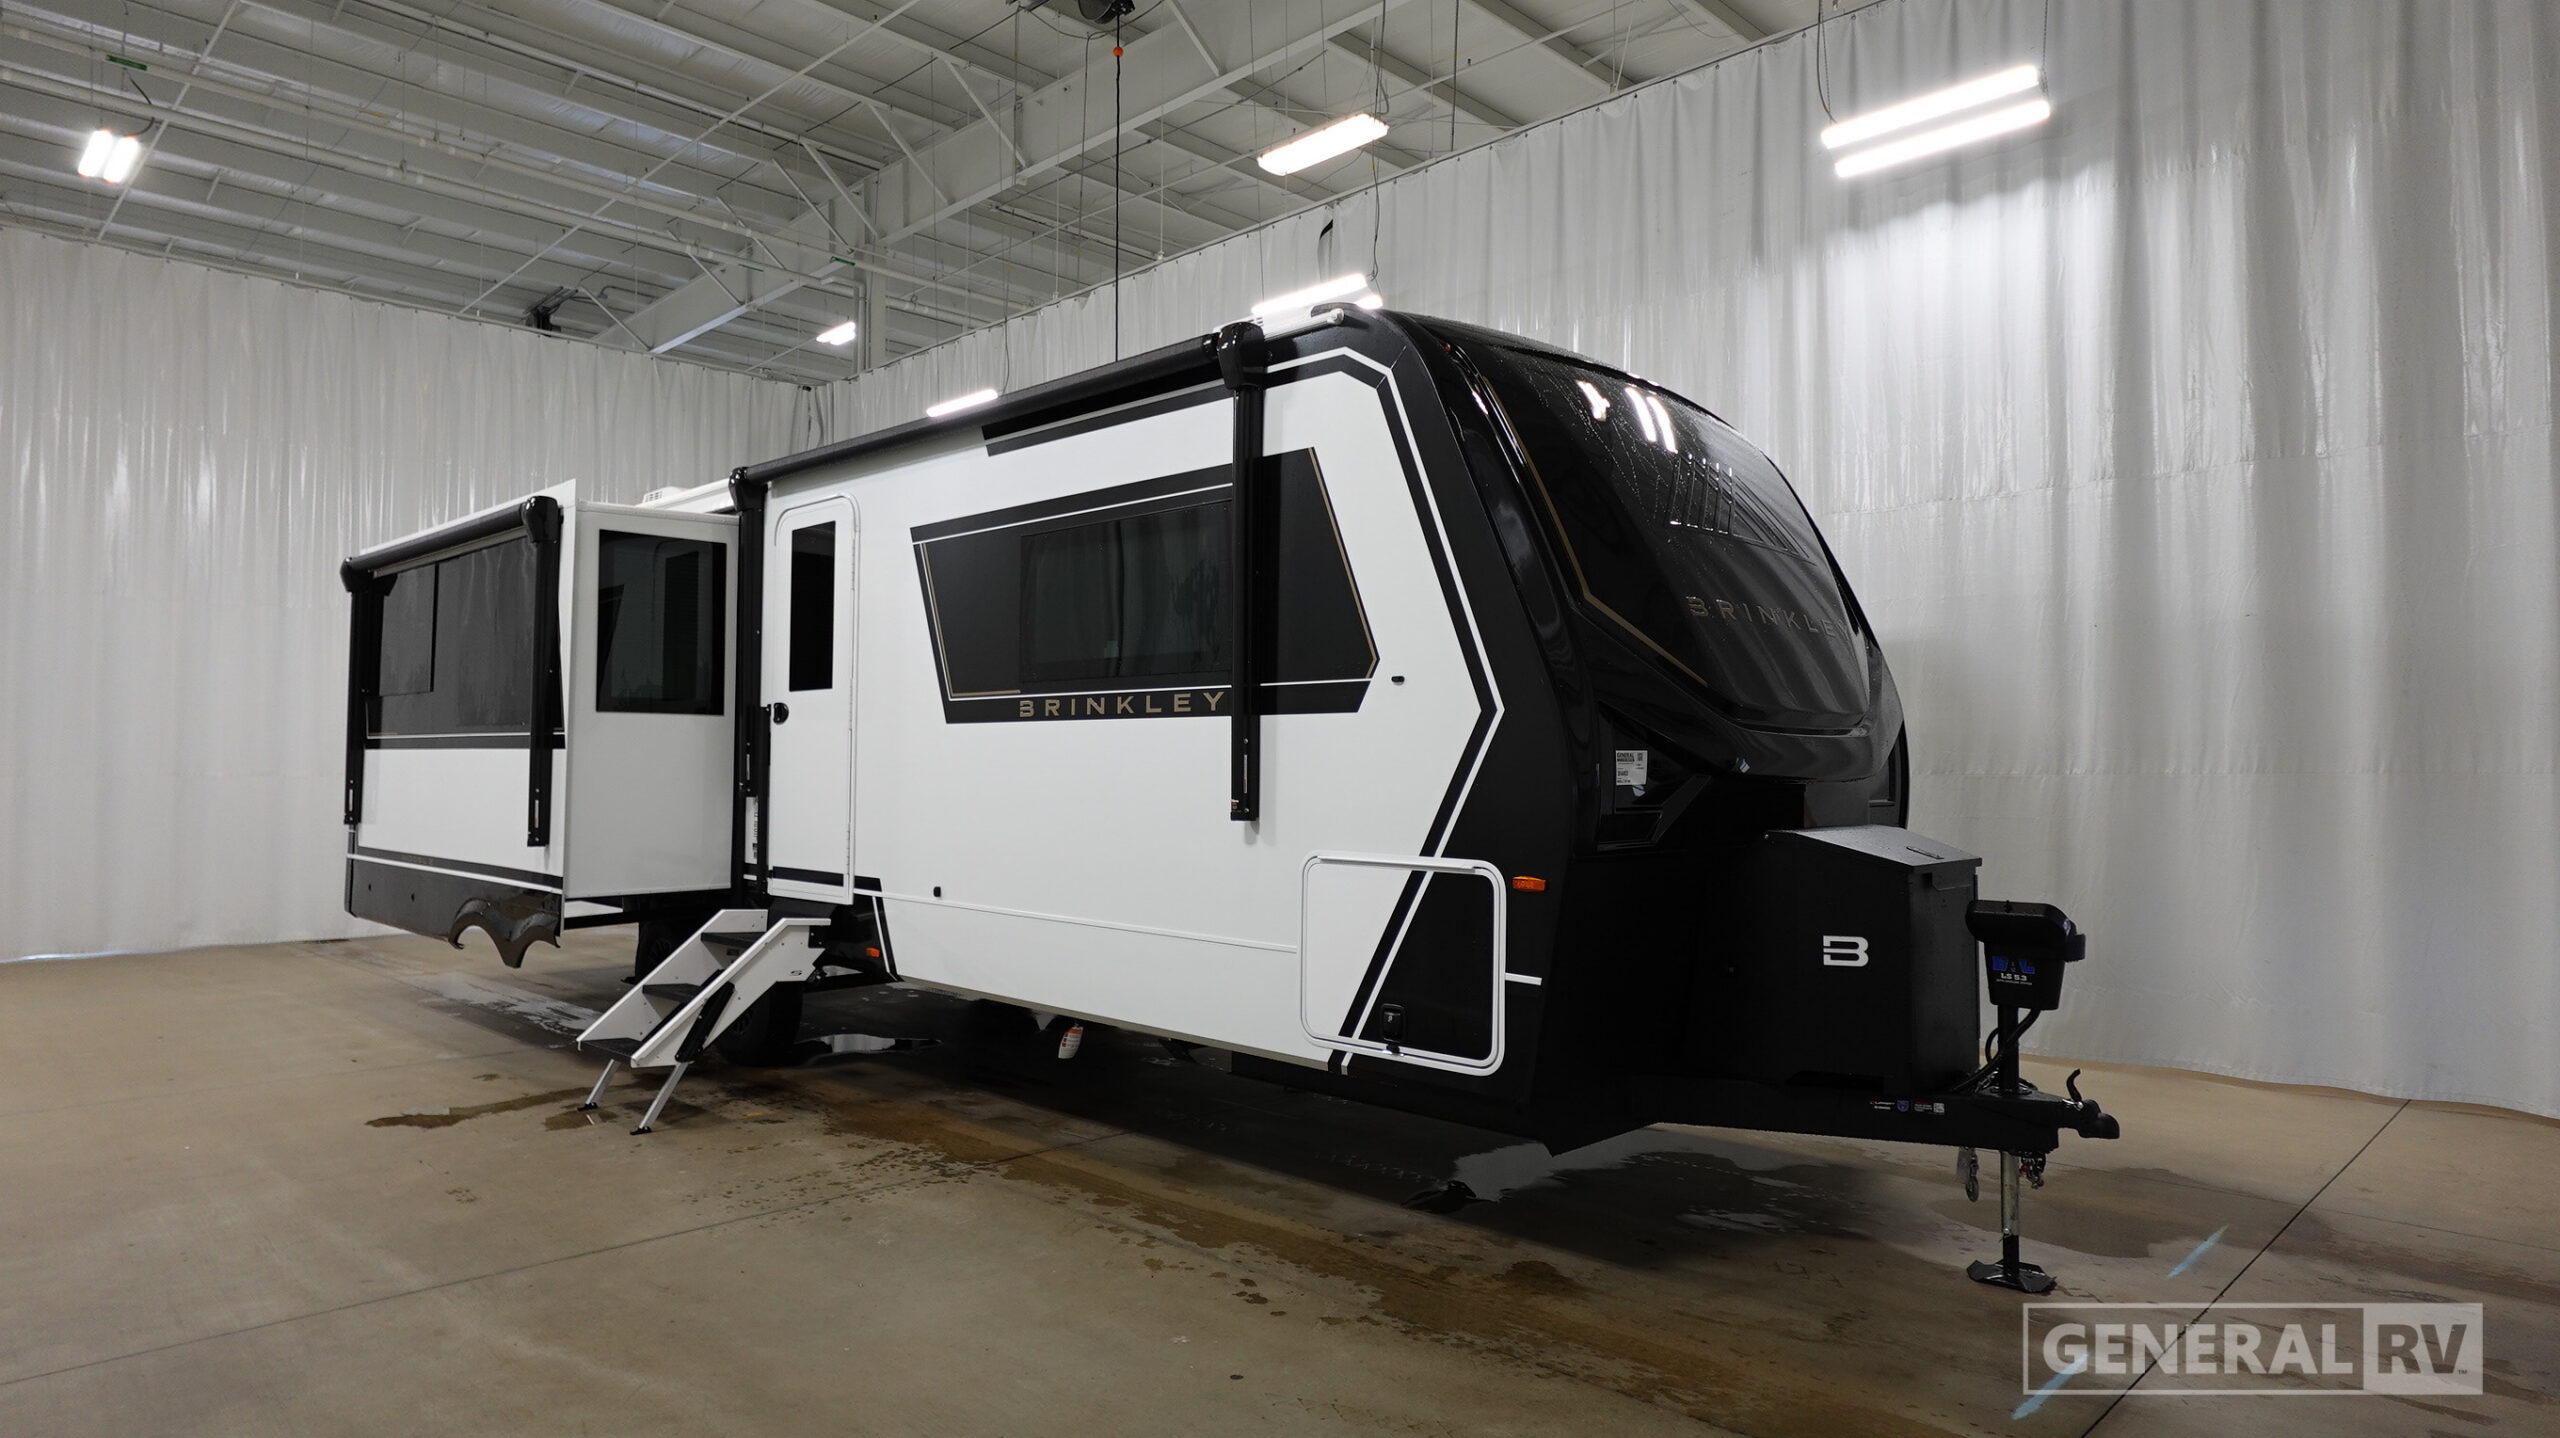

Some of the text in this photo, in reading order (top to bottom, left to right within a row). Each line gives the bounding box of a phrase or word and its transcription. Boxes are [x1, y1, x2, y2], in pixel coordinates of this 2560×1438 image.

[1686, 596, 1851, 639] BRINKLEY
[1019, 692, 1225, 718] BRINKLEY
[1823, 935, 1869, 967] B
